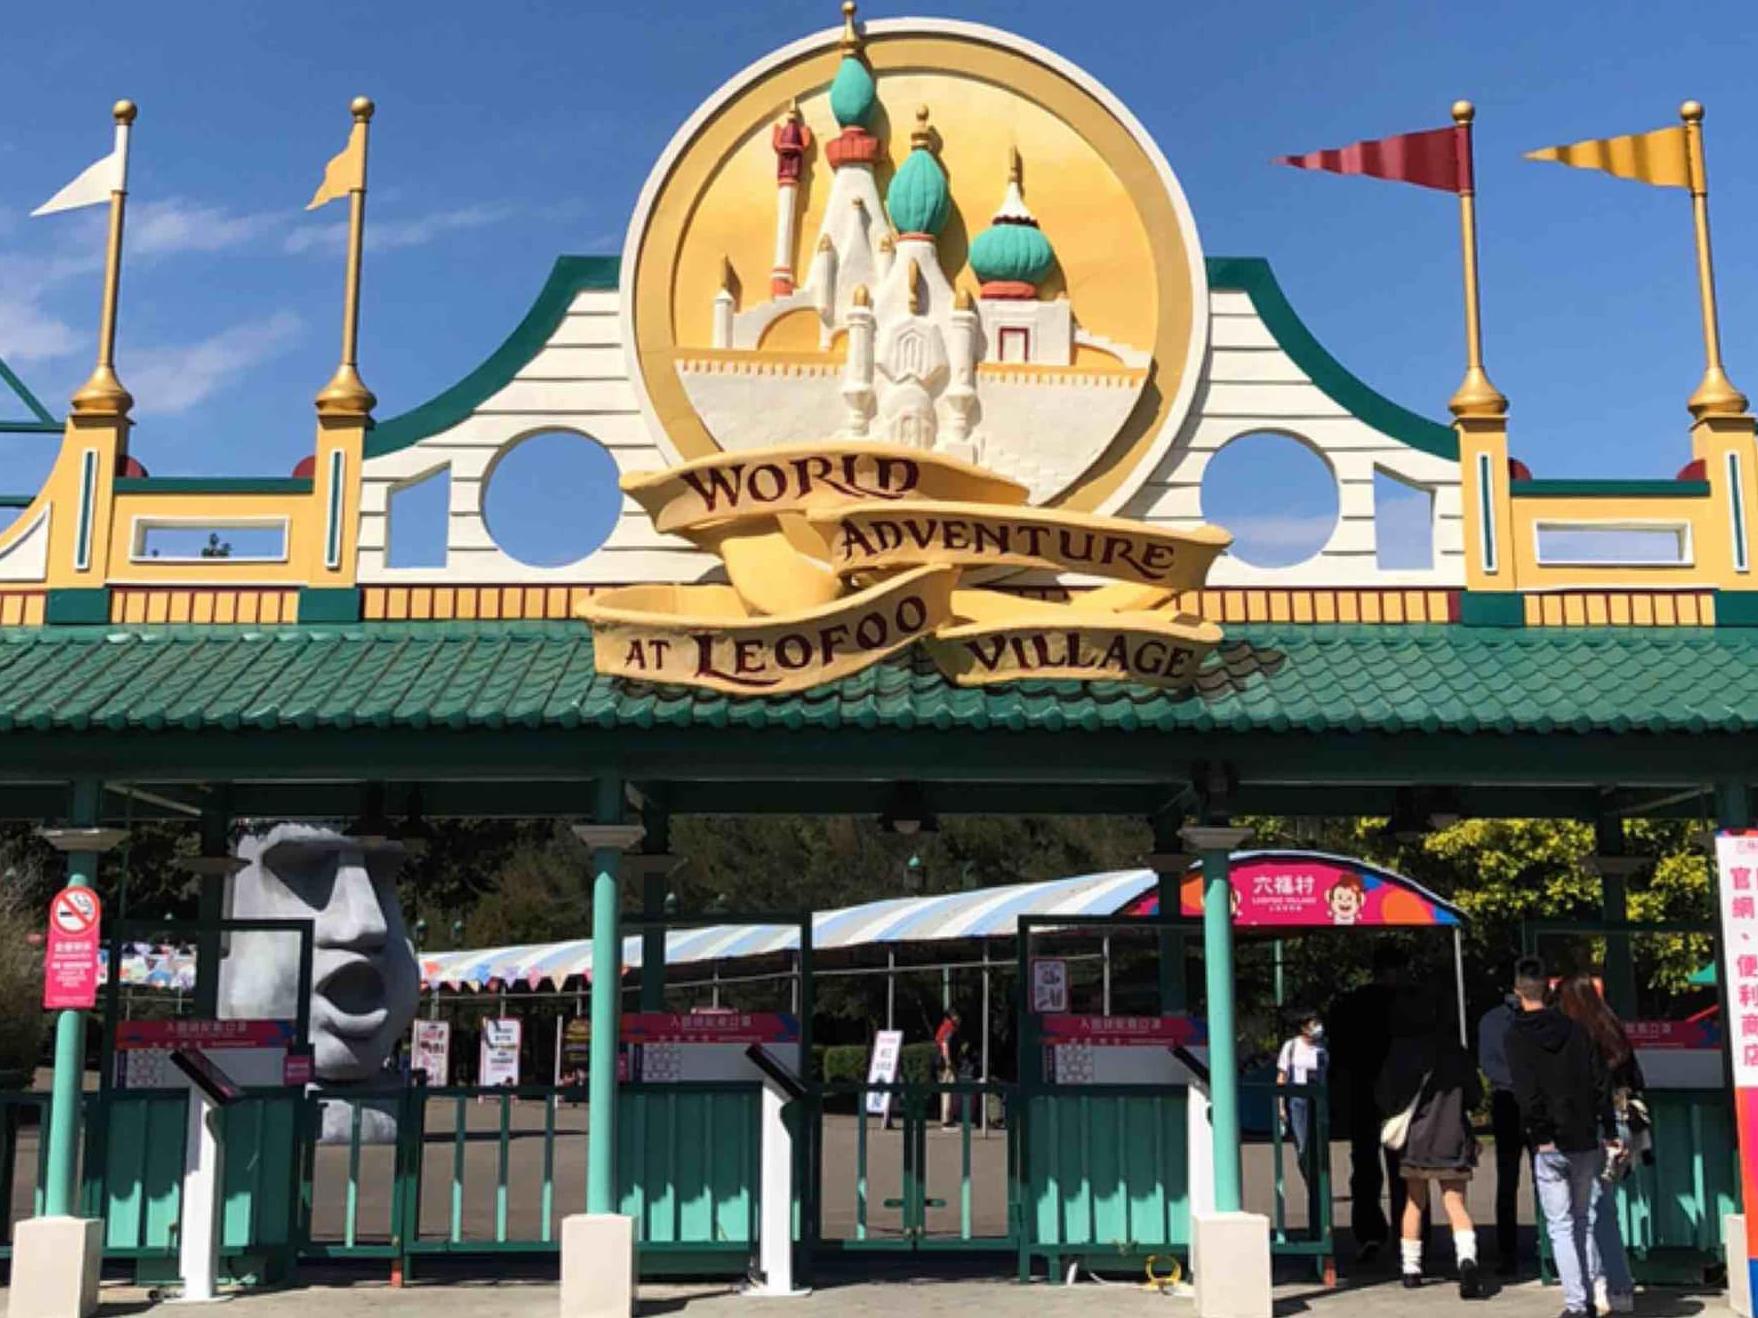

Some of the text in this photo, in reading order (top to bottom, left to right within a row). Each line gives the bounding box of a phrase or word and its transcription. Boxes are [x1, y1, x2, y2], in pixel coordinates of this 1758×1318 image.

[680, 453, 919, 513] WORLD
[840, 517, 1177, 580] ADVENTURE
[625, 595, 928, 686] AT LEOFOO
[966, 630, 1195, 680] VILLAGE
